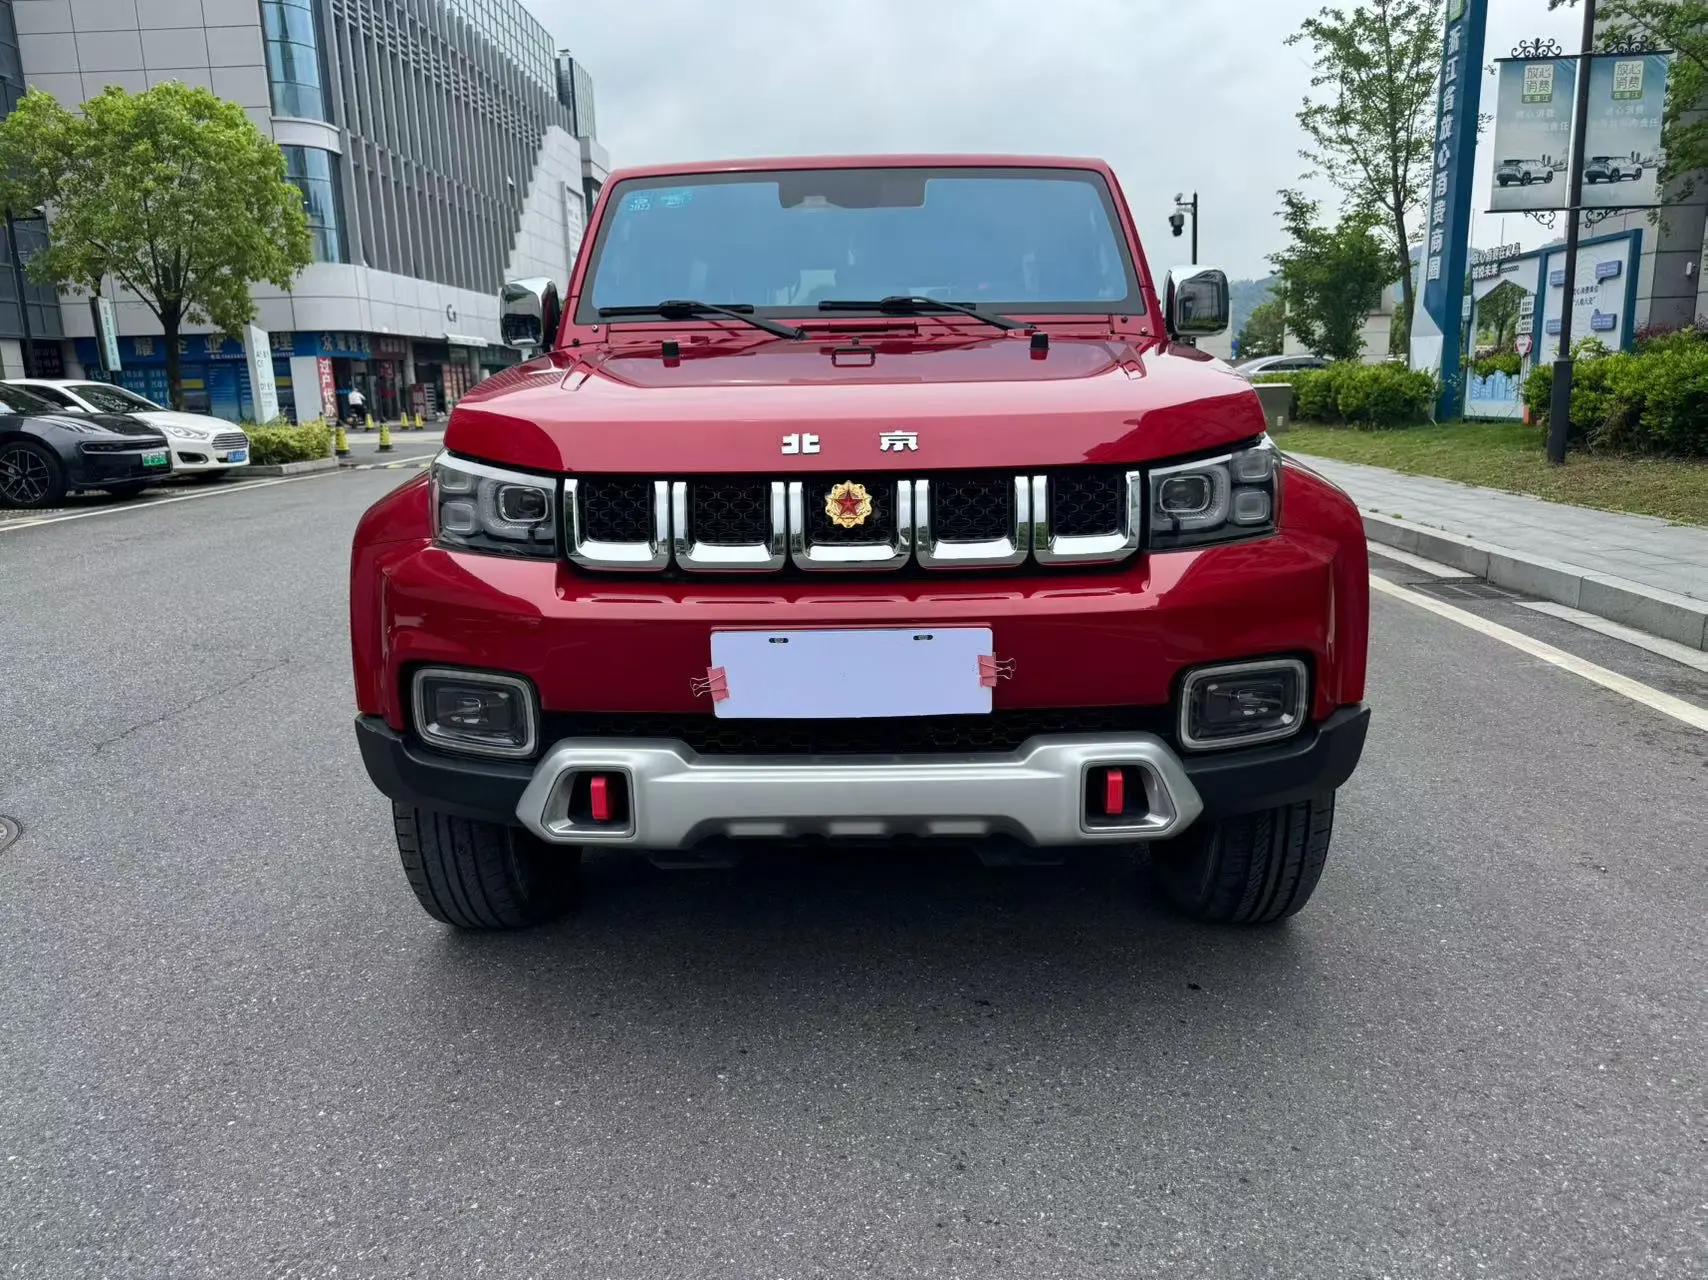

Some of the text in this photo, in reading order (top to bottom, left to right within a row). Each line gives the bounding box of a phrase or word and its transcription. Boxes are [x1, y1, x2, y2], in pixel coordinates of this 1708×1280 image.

[1526, 66, 1551, 80] 放心
[1616, 63, 1641, 76] 放心
[1525, 79, 1551, 94] 消费
[1615, 76, 1640, 90] 消费
[1428, 24, 1462, 280] 浙江省放心消费商圈
[781, 430, 919, 455] 北京
